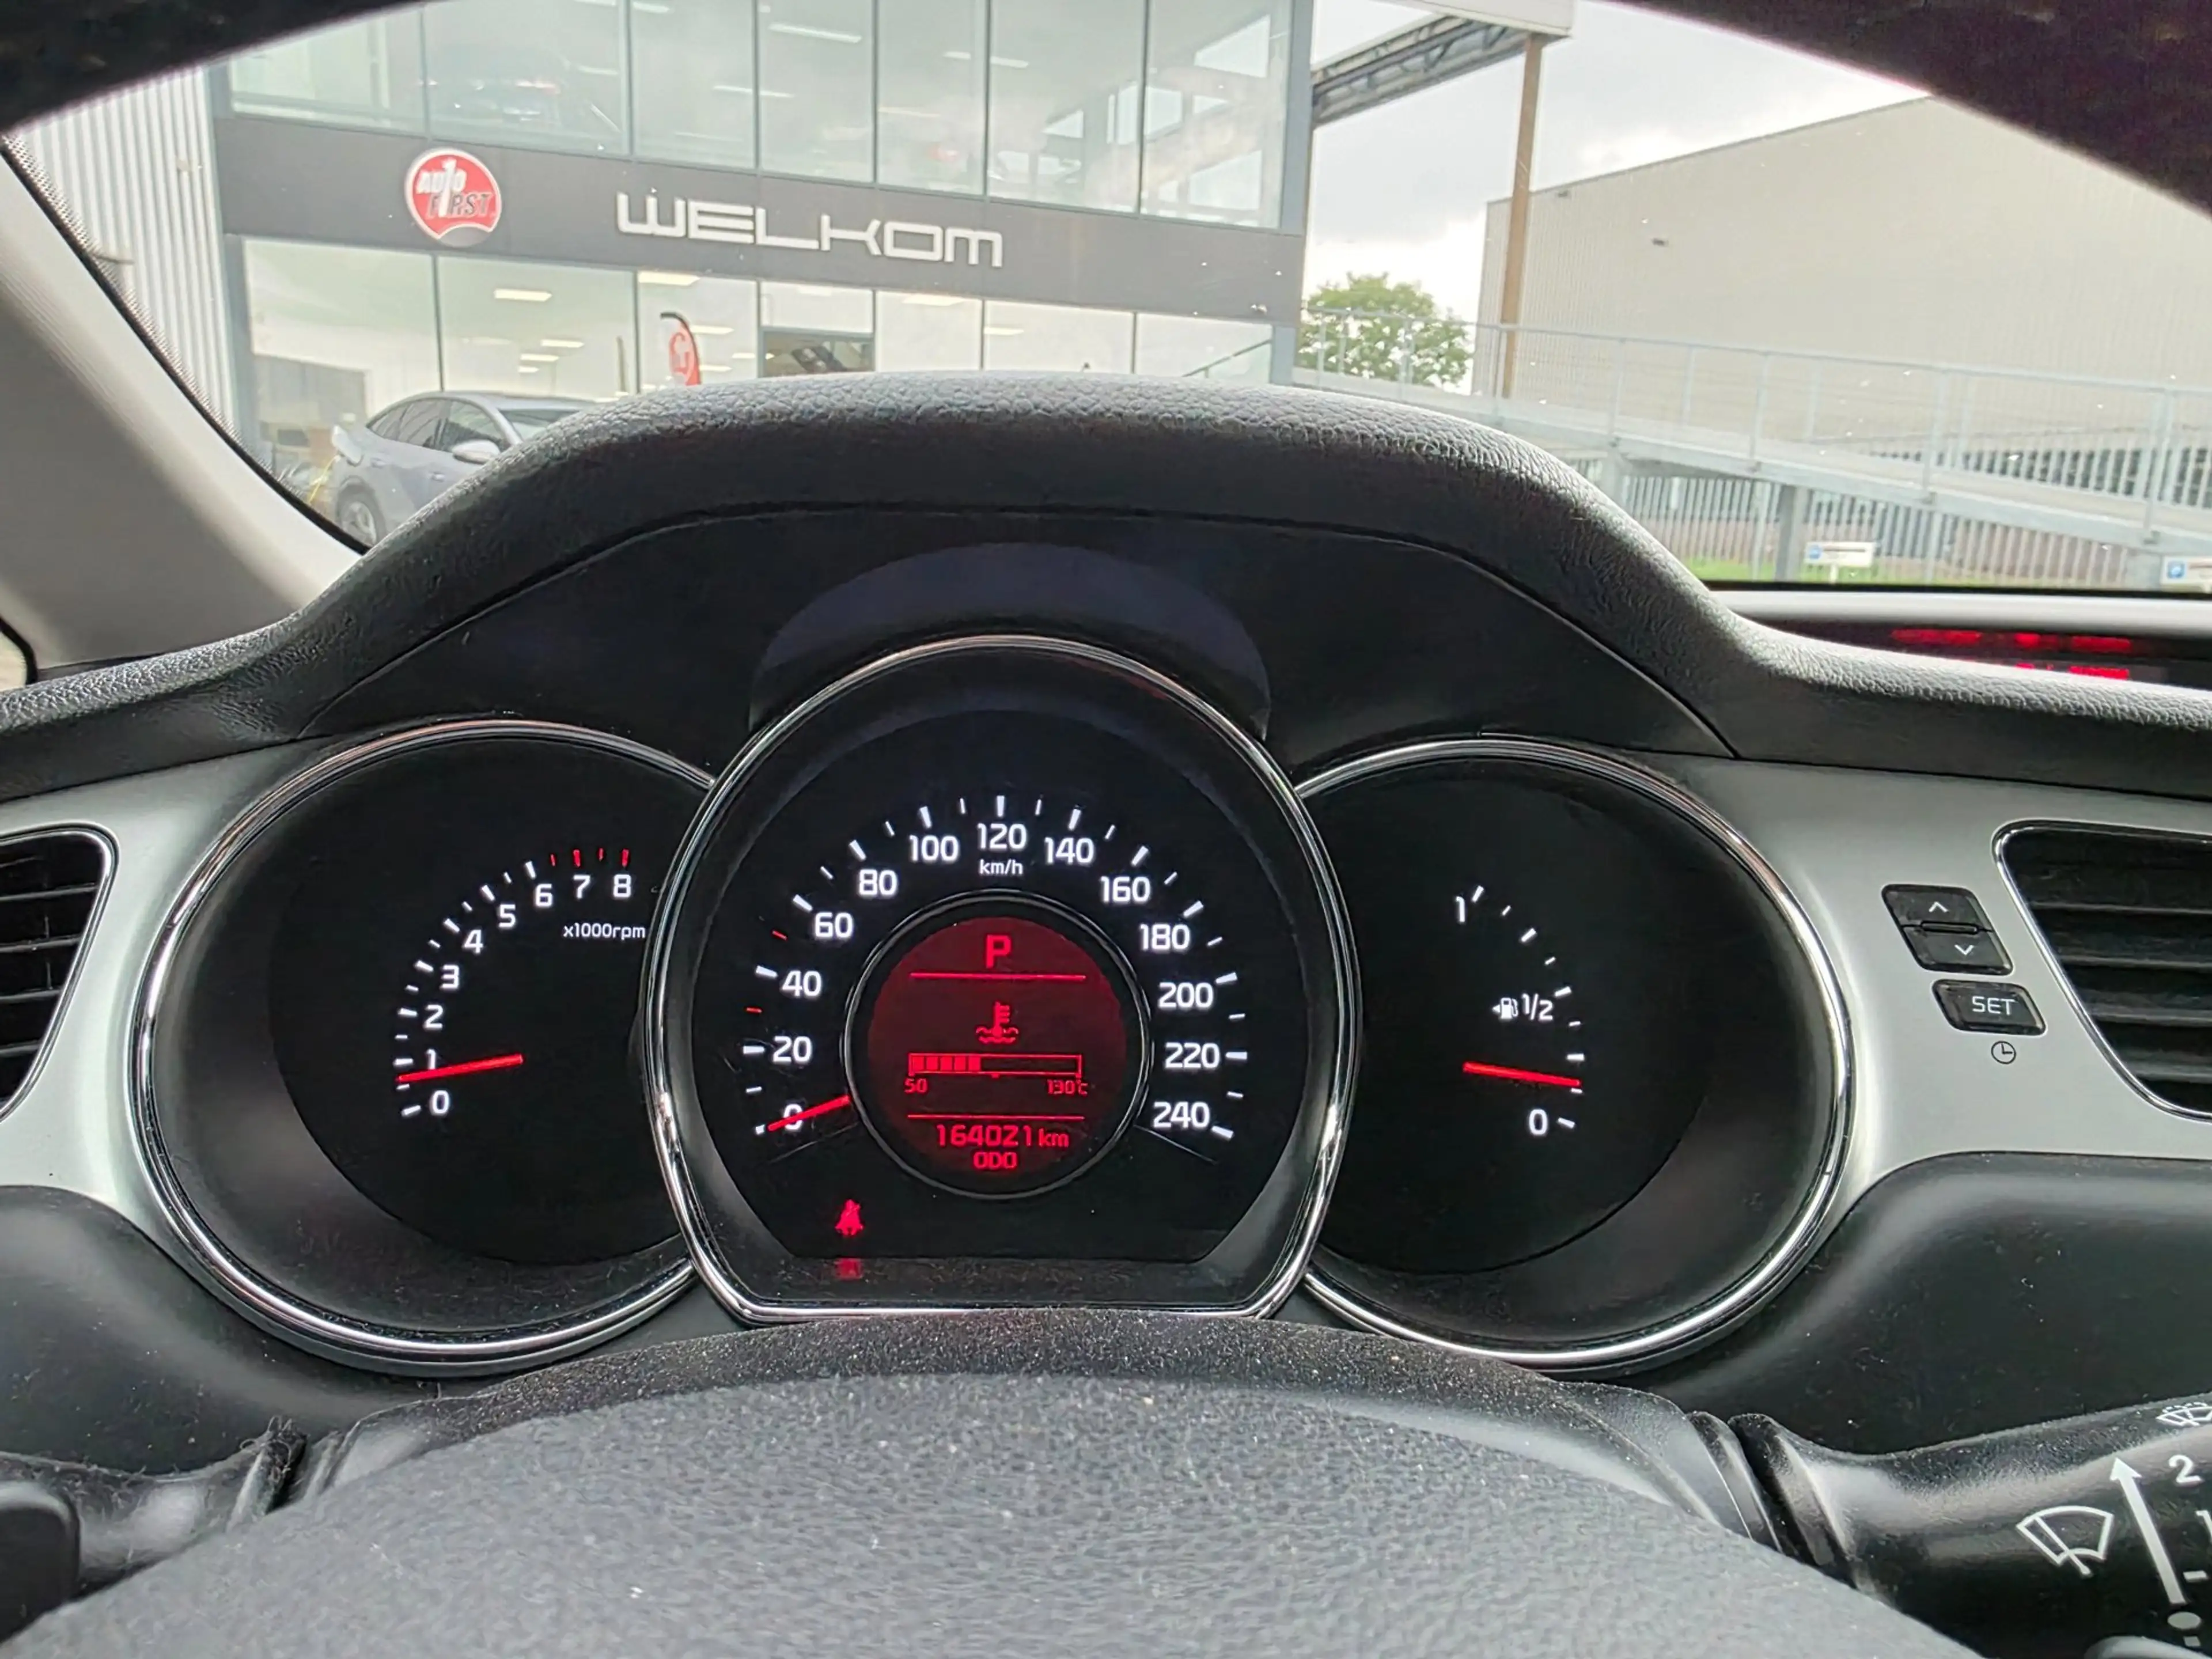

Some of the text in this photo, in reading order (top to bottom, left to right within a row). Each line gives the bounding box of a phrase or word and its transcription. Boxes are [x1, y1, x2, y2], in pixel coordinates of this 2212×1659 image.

[616, 192, 1003, 268] WELKOM
[909, 835, 960, 862] 100
[977, 823, 1027, 850] 120
[1044, 836, 1094, 864] 140
[979, 859, 1023, 875] km/h
[535, 883, 553, 908] 6
[573, 874, 591, 899] 7
[612, 874, 632, 899] 8
[858, 869, 897, 897] 80
[1100, 876, 1151, 904] 160
[498, 904, 516, 929] 5
[1455, 896, 1465, 923] 1
[563, 922, 646, 941] x1000rpm
[814, 911, 854, 940] 60
[1139, 923, 1191, 952] 180
[463, 929, 484, 954] 4
[986, 934, 1012, 968] P
[440, 964, 460, 990] 3
[781, 970, 822, 998] 40
[1158, 982, 1214, 1010] 200
[1522, 993, 1554, 1021] 1/2
[1972, 995, 2016, 1016] SET
[424, 1004, 444, 1029] 2
[426, 1048, 437, 1070] 1
[772, 1036, 812, 1063] 20
[1165, 1042, 1220, 1070] 220
[904, 1078, 928, 1093] 50
[430, 1090, 450, 1115] 0
[1153, 1101, 1210, 1129] 240
[783, 1103, 803, 1131] 0
[1528, 1109, 1548, 1136] 0
[937, 1124, 1069, 1147] 164021 km
[973, 1151, 1017, 1169] ODO
[2168, 1455, 2205, 1484] 2
